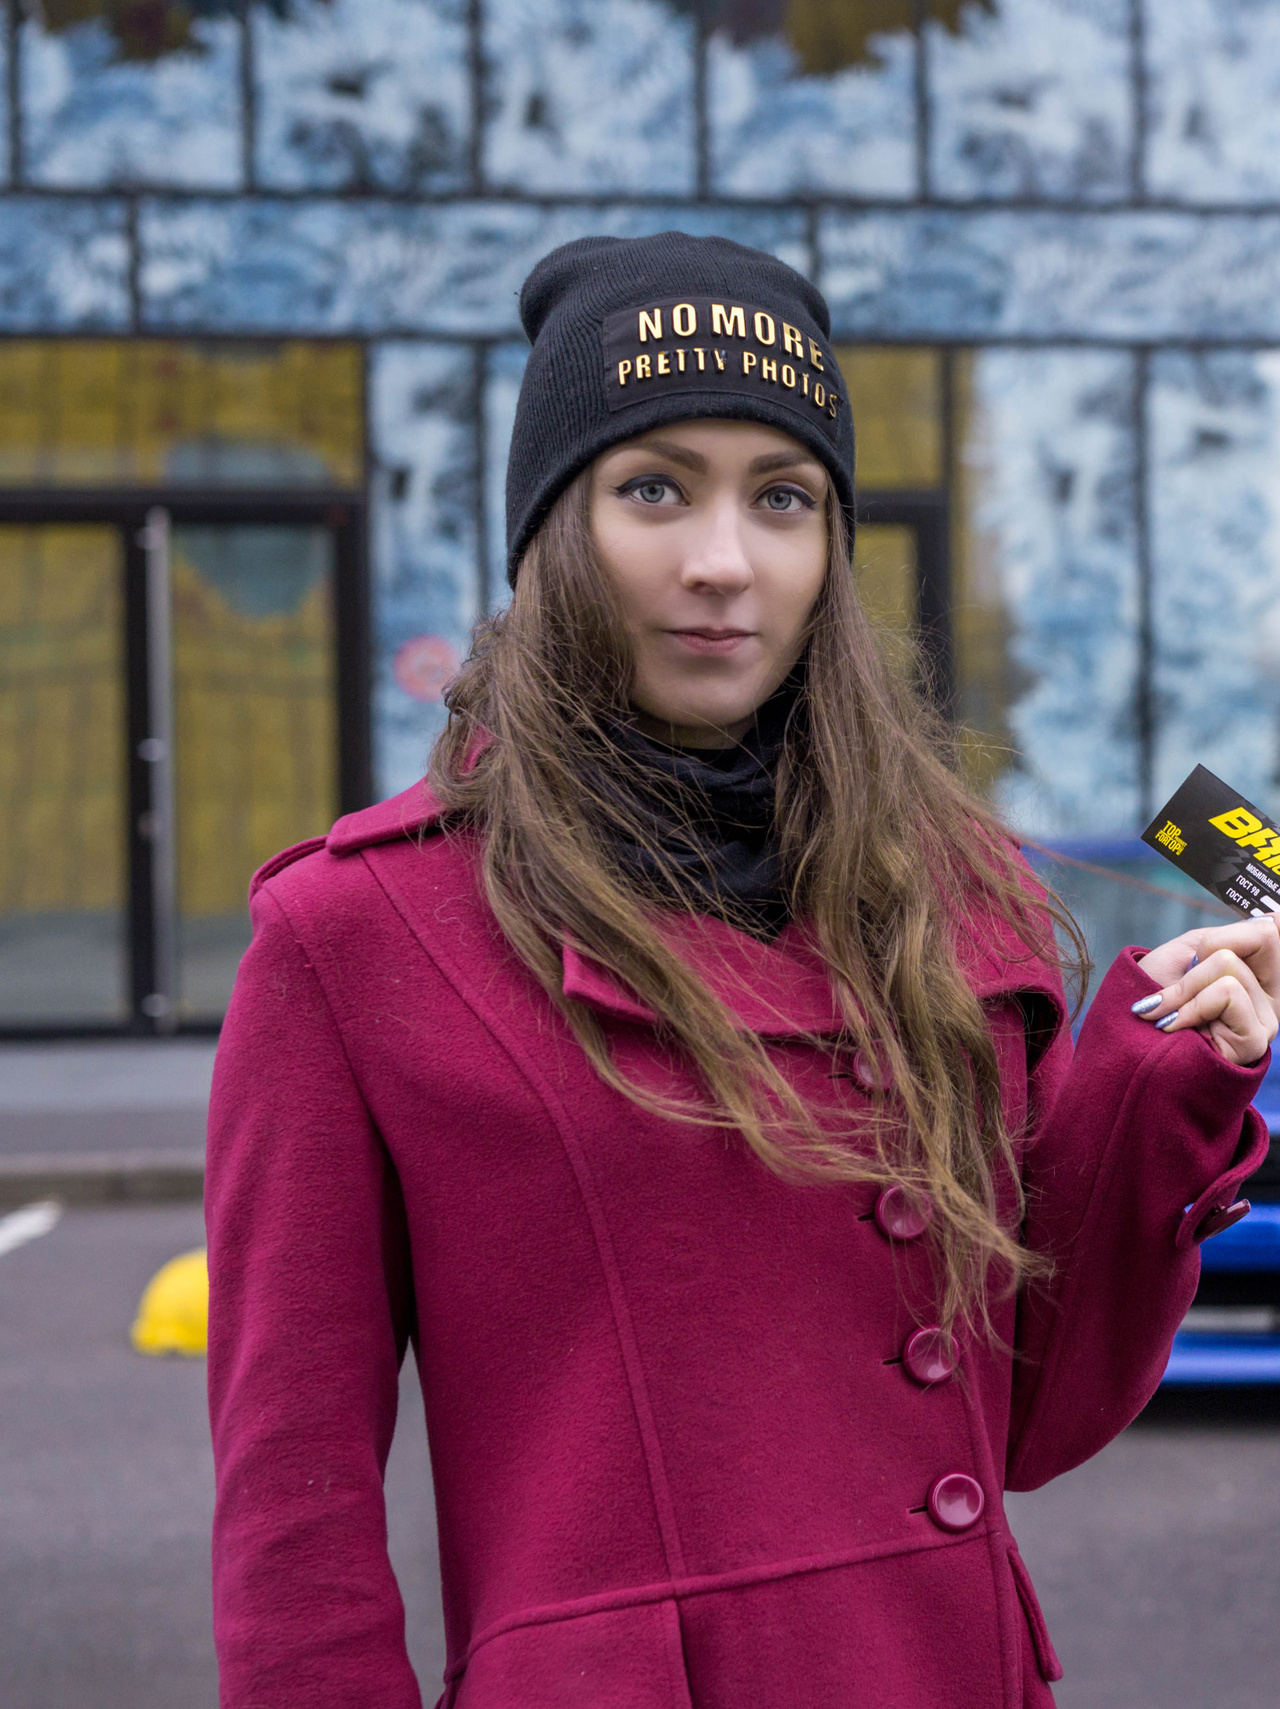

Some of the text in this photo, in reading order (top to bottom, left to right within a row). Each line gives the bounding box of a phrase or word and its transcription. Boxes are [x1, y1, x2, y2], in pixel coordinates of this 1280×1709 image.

[638, 303, 825, 372] NO MORE
[617, 347, 838, 419] PRETTY PHOTOS
[1163, 820, 1182, 838] TOP
[1235, 874, 1260, 896] ГОСТ 98
[1245, 862, 1279, 891] МОБИЛЬНЫЕ
[1225, 887, 1250, 909] ГОСТ 95
